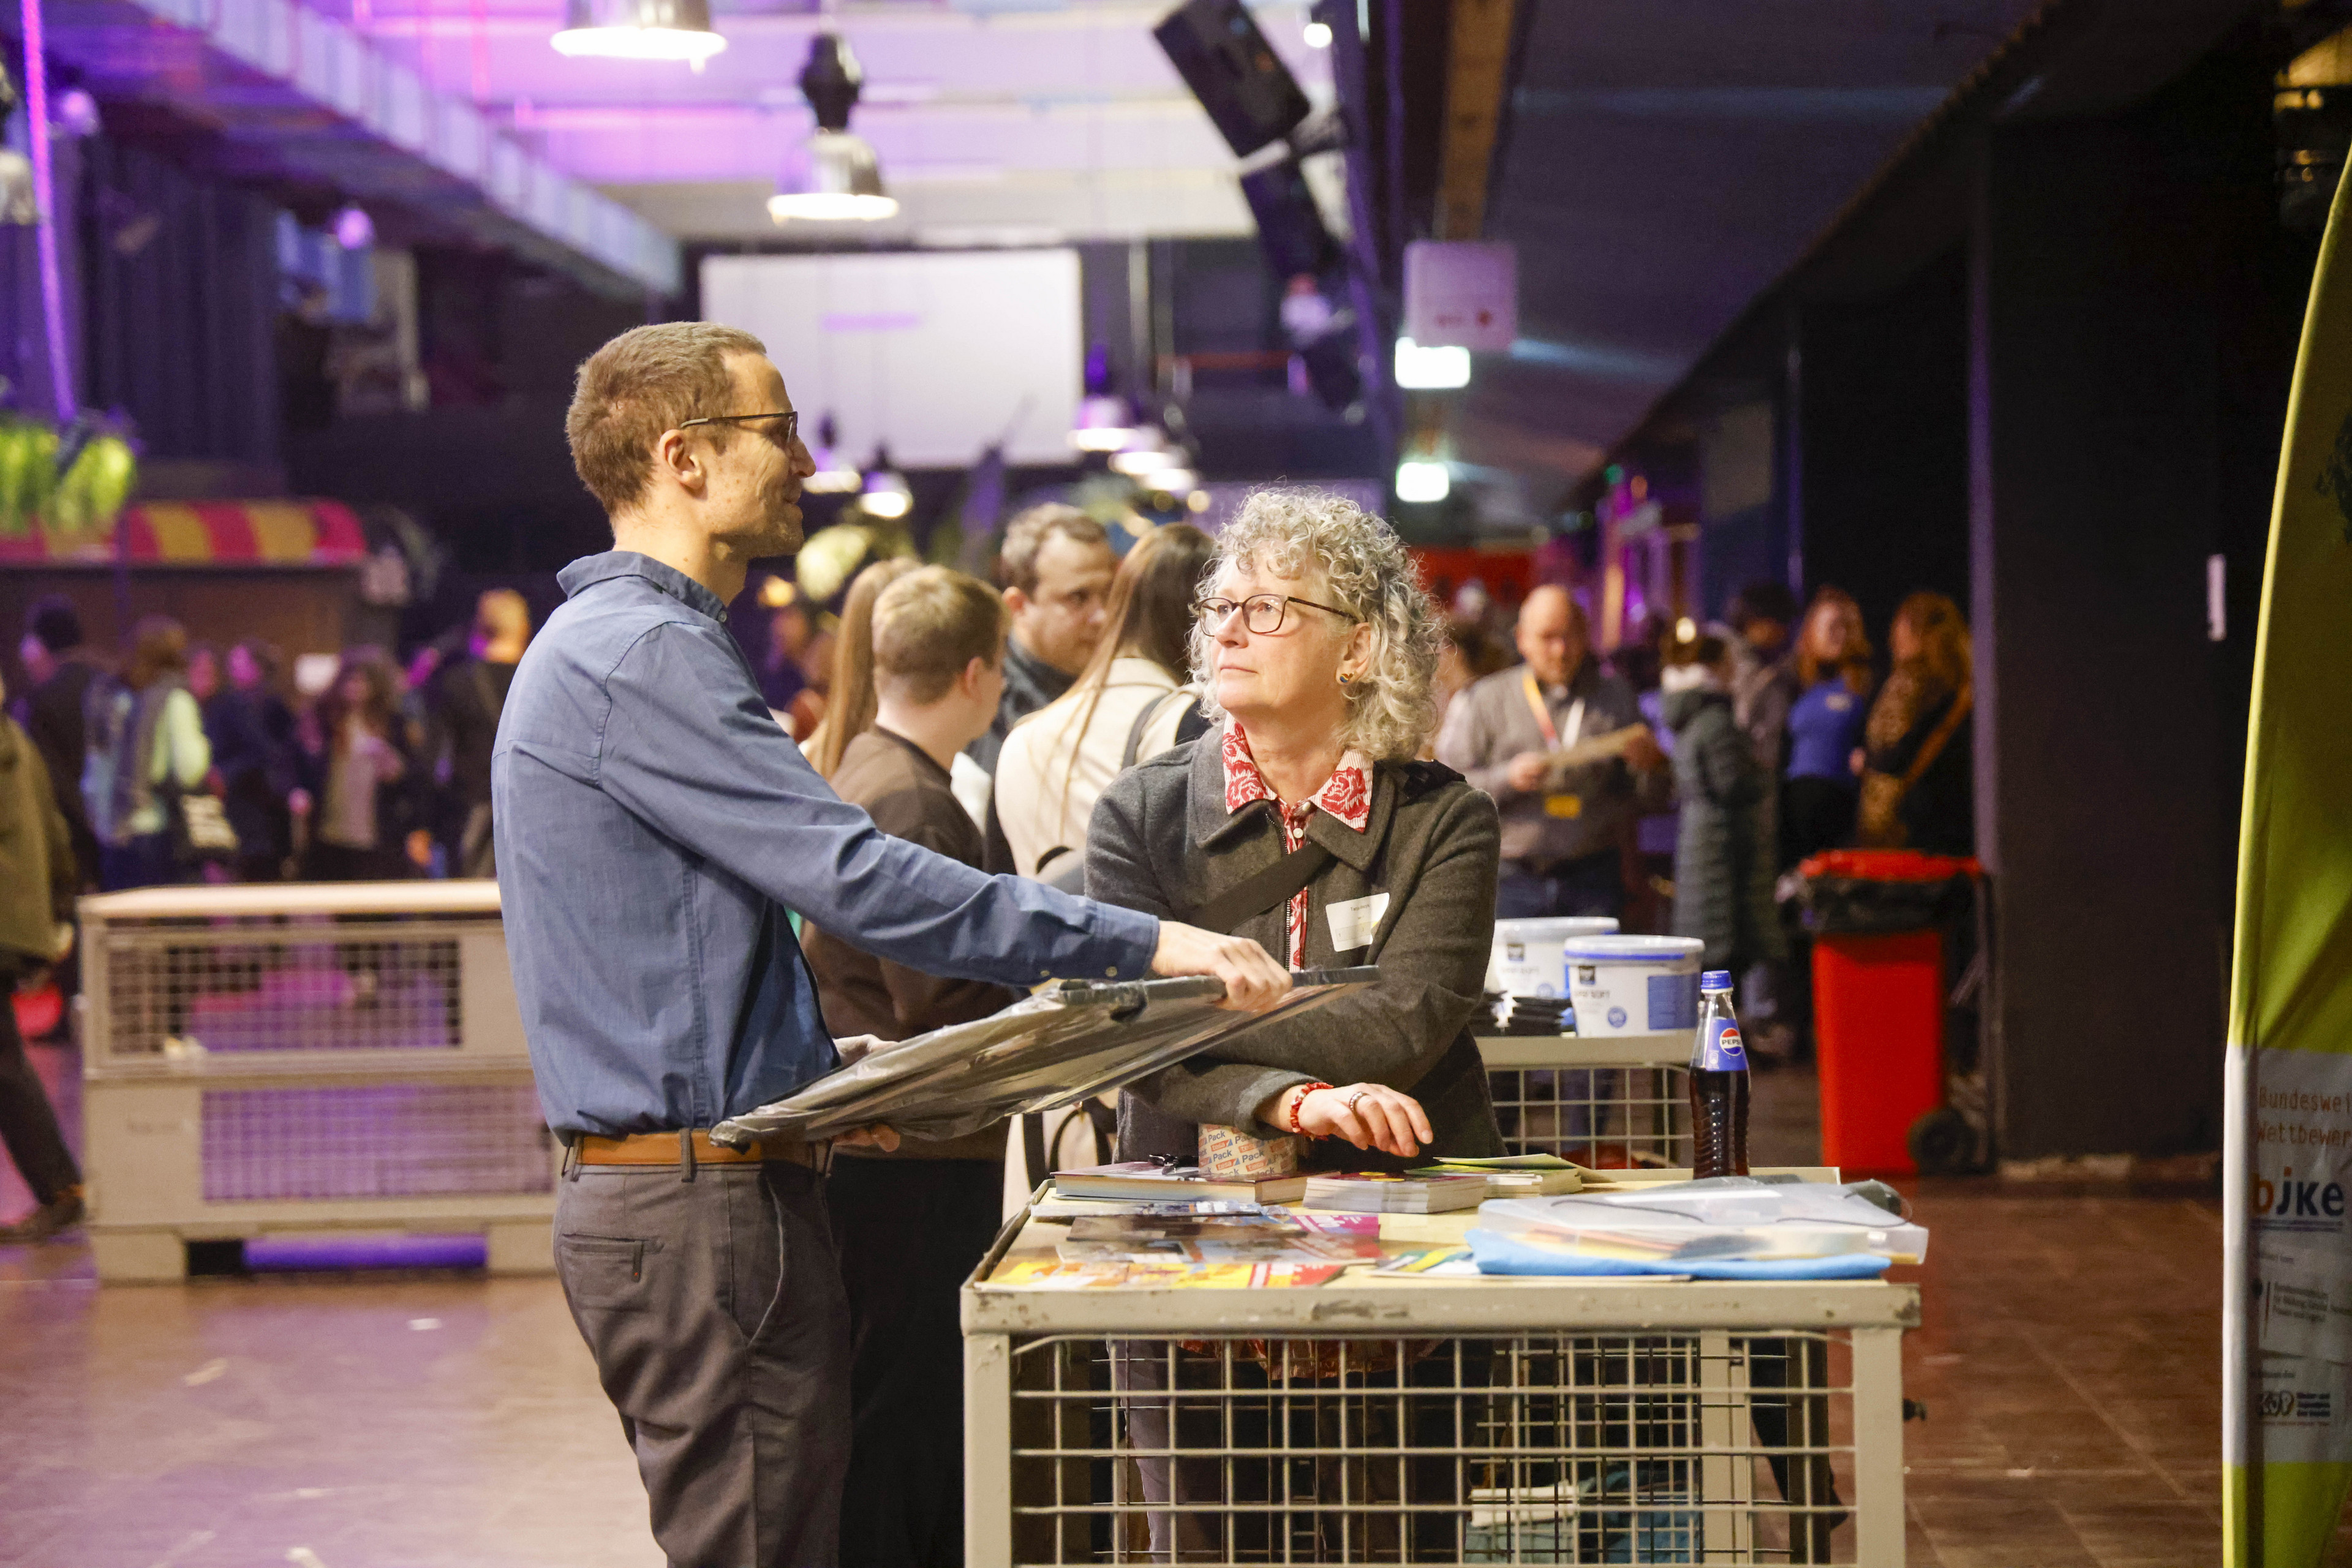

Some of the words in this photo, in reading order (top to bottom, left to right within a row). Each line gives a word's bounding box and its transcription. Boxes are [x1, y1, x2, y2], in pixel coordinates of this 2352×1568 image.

[1208, 1130, 1226, 1142] Pack
[1213, 1150, 1232, 1161] Pack
[1242, 1150, 1264, 1163] Pack
